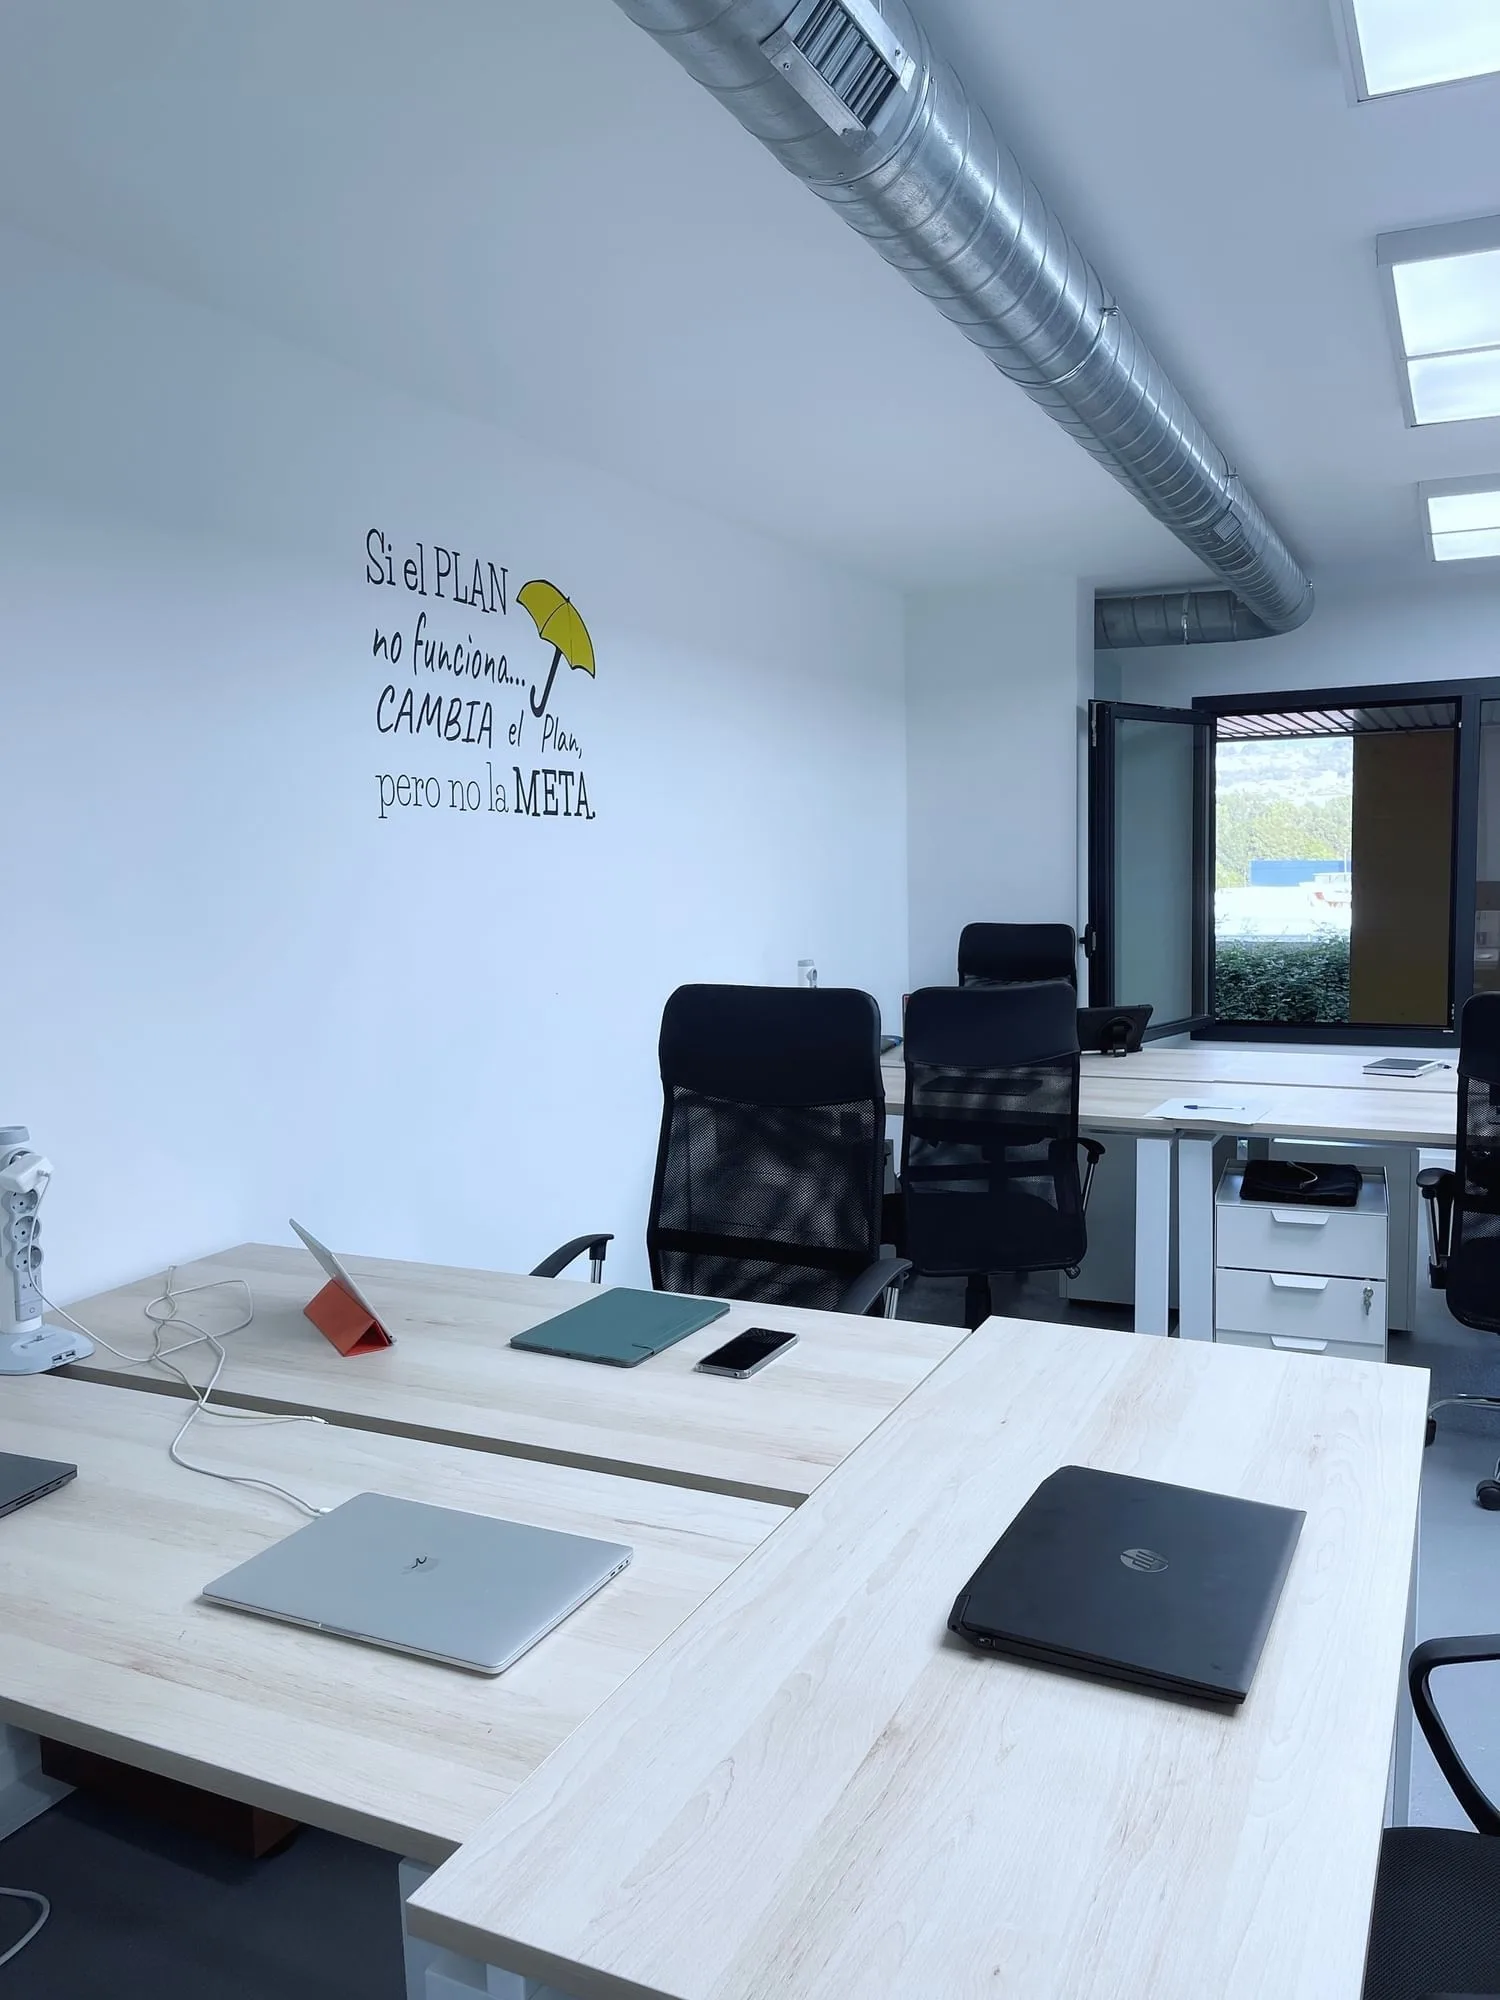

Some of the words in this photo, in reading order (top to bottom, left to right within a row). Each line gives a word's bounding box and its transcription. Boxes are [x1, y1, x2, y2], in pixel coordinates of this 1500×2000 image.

[366, 528, 396, 586] Si
[403, 542, 428, 596] el
[433, 546, 509, 616] PLAN
[372, 628, 402, 664] no
[413, 611, 526, 688] funciona...
[376, 684, 493, 749] CAMBIA
[508, 709, 524, 747] el
[541, 713, 583, 760] Plan,
[375, 773, 441, 819] pero
[447, 779, 481, 811] no
[486, 761, 509, 813] la
